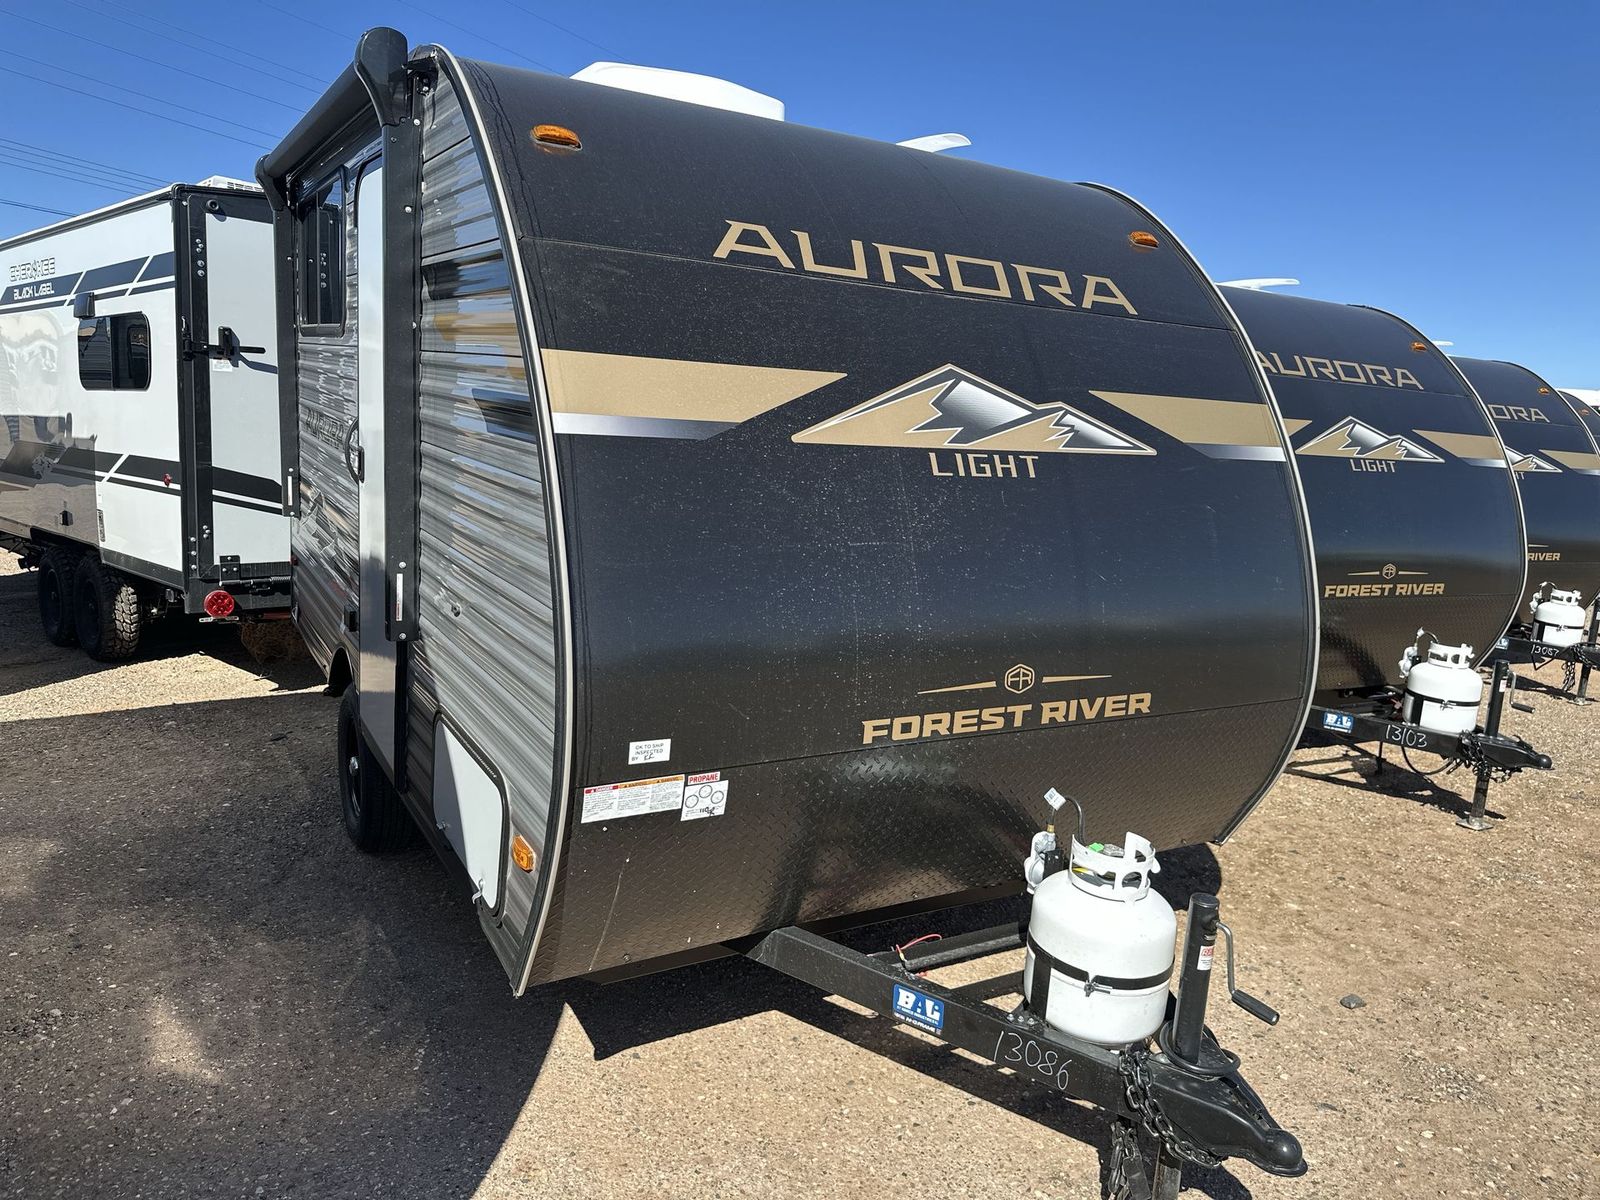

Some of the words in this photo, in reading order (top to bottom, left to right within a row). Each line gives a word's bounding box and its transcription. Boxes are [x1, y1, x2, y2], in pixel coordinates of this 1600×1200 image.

[713, 219, 1138, 316] AURORA
[13, 286, 34, 300] BLACK
[34, 282, 55, 297] LABEL
[929, 452, 1039, 479] LIGHT
[1350, 459, 1396, 473] LIGHT
[1527, 552, 1561, 561] RIVER
[1324, 583, 1393, 598] FOREST
[1395, 583, 1445, 596] RIVER
[862, 703, 1032, 745] FOREST
[1040, 692, 1152, 725] RIVER
[1326, 713, 1352, 726] BAL
[1385, 724, 1428, 748] 13103
[689, 773, 719, 783] PROPANE
[897, 988, 940, 1021] BAL
[993, 1029, 1070, 1091] 13086
